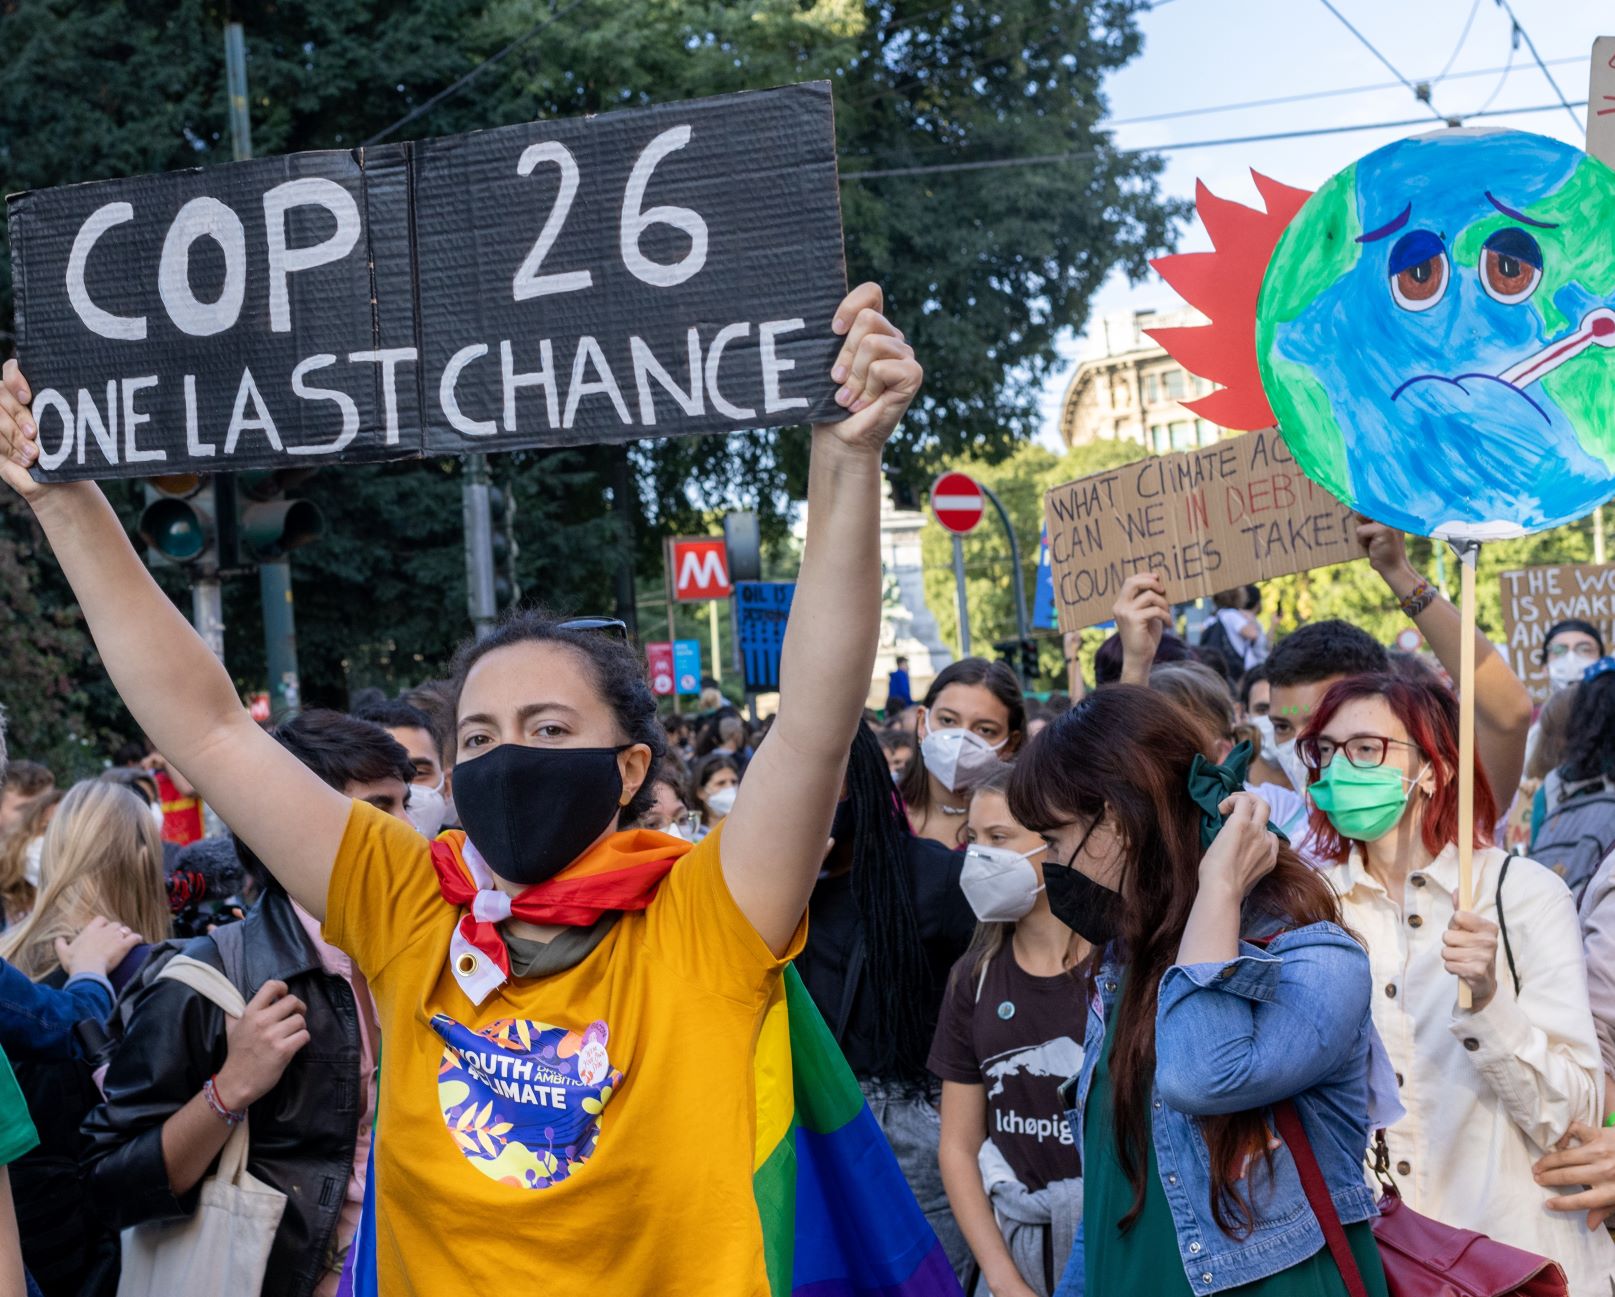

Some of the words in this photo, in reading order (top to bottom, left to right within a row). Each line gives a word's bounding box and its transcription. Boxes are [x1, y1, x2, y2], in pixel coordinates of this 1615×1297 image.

[66, 178, 361, 340] COP
[512, 125, 710, 302] 26
[33, 375, 167, 472] ONE
[184, 347, 418, 457] LAST
[439, 317, 808, 437] CHANCE
[1051, 476, 1119, 522] WHAT
[1052, 518, 1103, 564] CAN
[1115, 502, 1165, 544] WE
[1185, 488, 1209, 535] IN
[1240, 501, 1354, 560] TAKE?
[678, 550, 729, 589] M
[1502, 567, 1562, 596] THE
[1511, 596, 1539, 622] IS
[1511, 620, 1556, 648] AN
